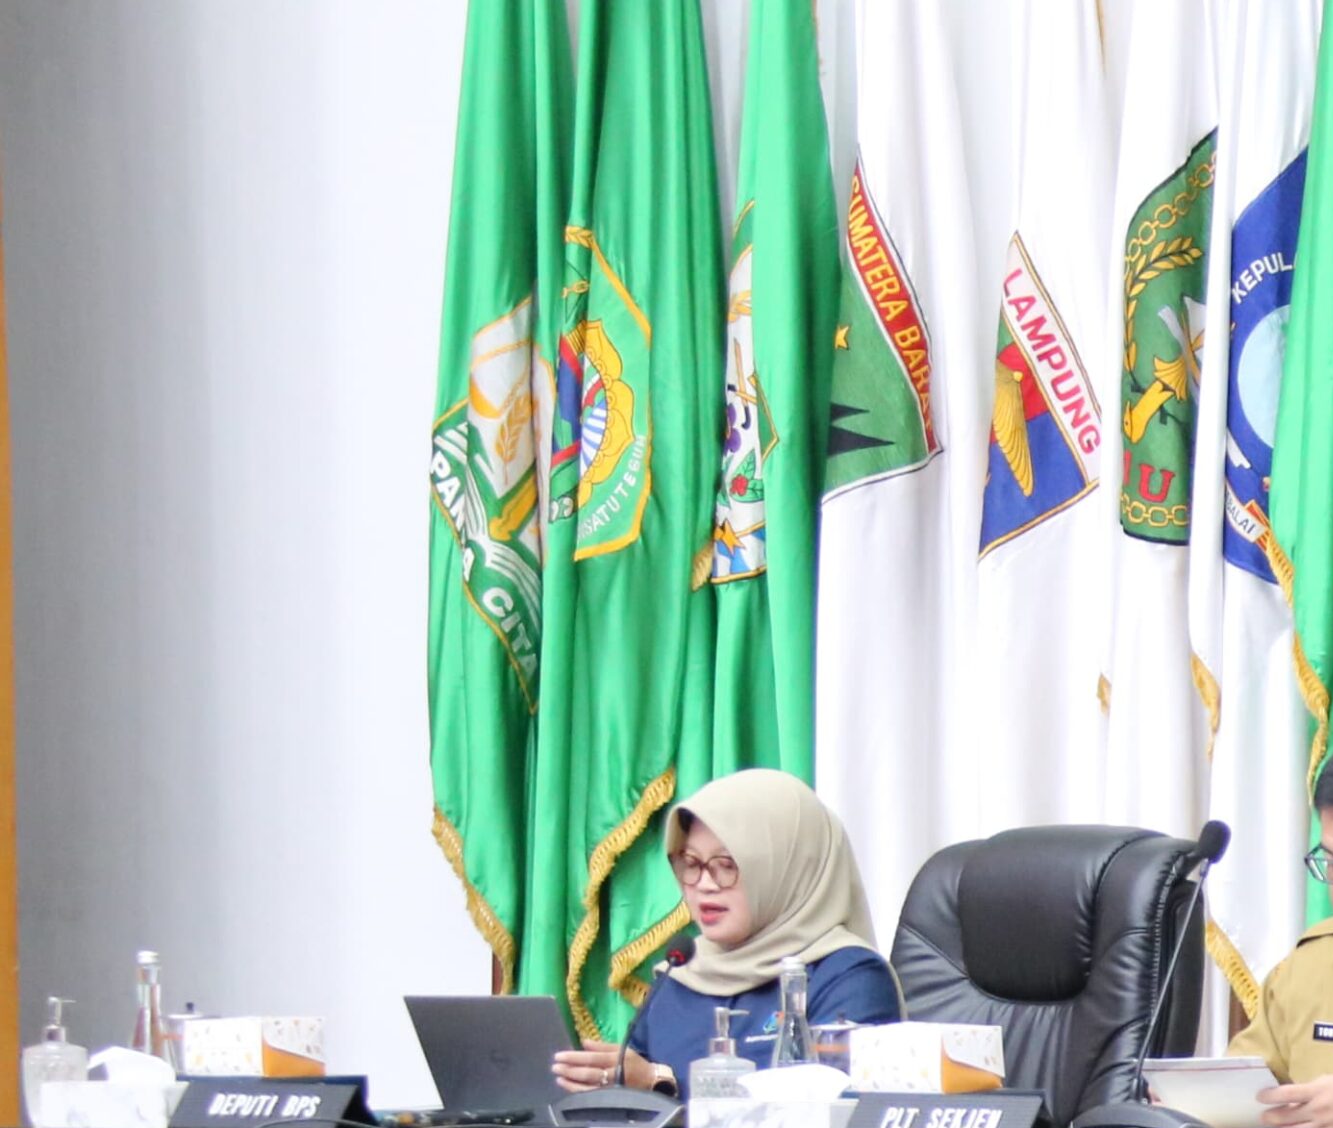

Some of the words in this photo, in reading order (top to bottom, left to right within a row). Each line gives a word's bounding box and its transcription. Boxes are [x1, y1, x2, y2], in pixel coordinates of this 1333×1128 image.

[1003, 268, 1101, 454] LAMPUNG
[208, 1093, 279, 1117] DEPUTI
[281, 1094, 321, 1118] BPS
